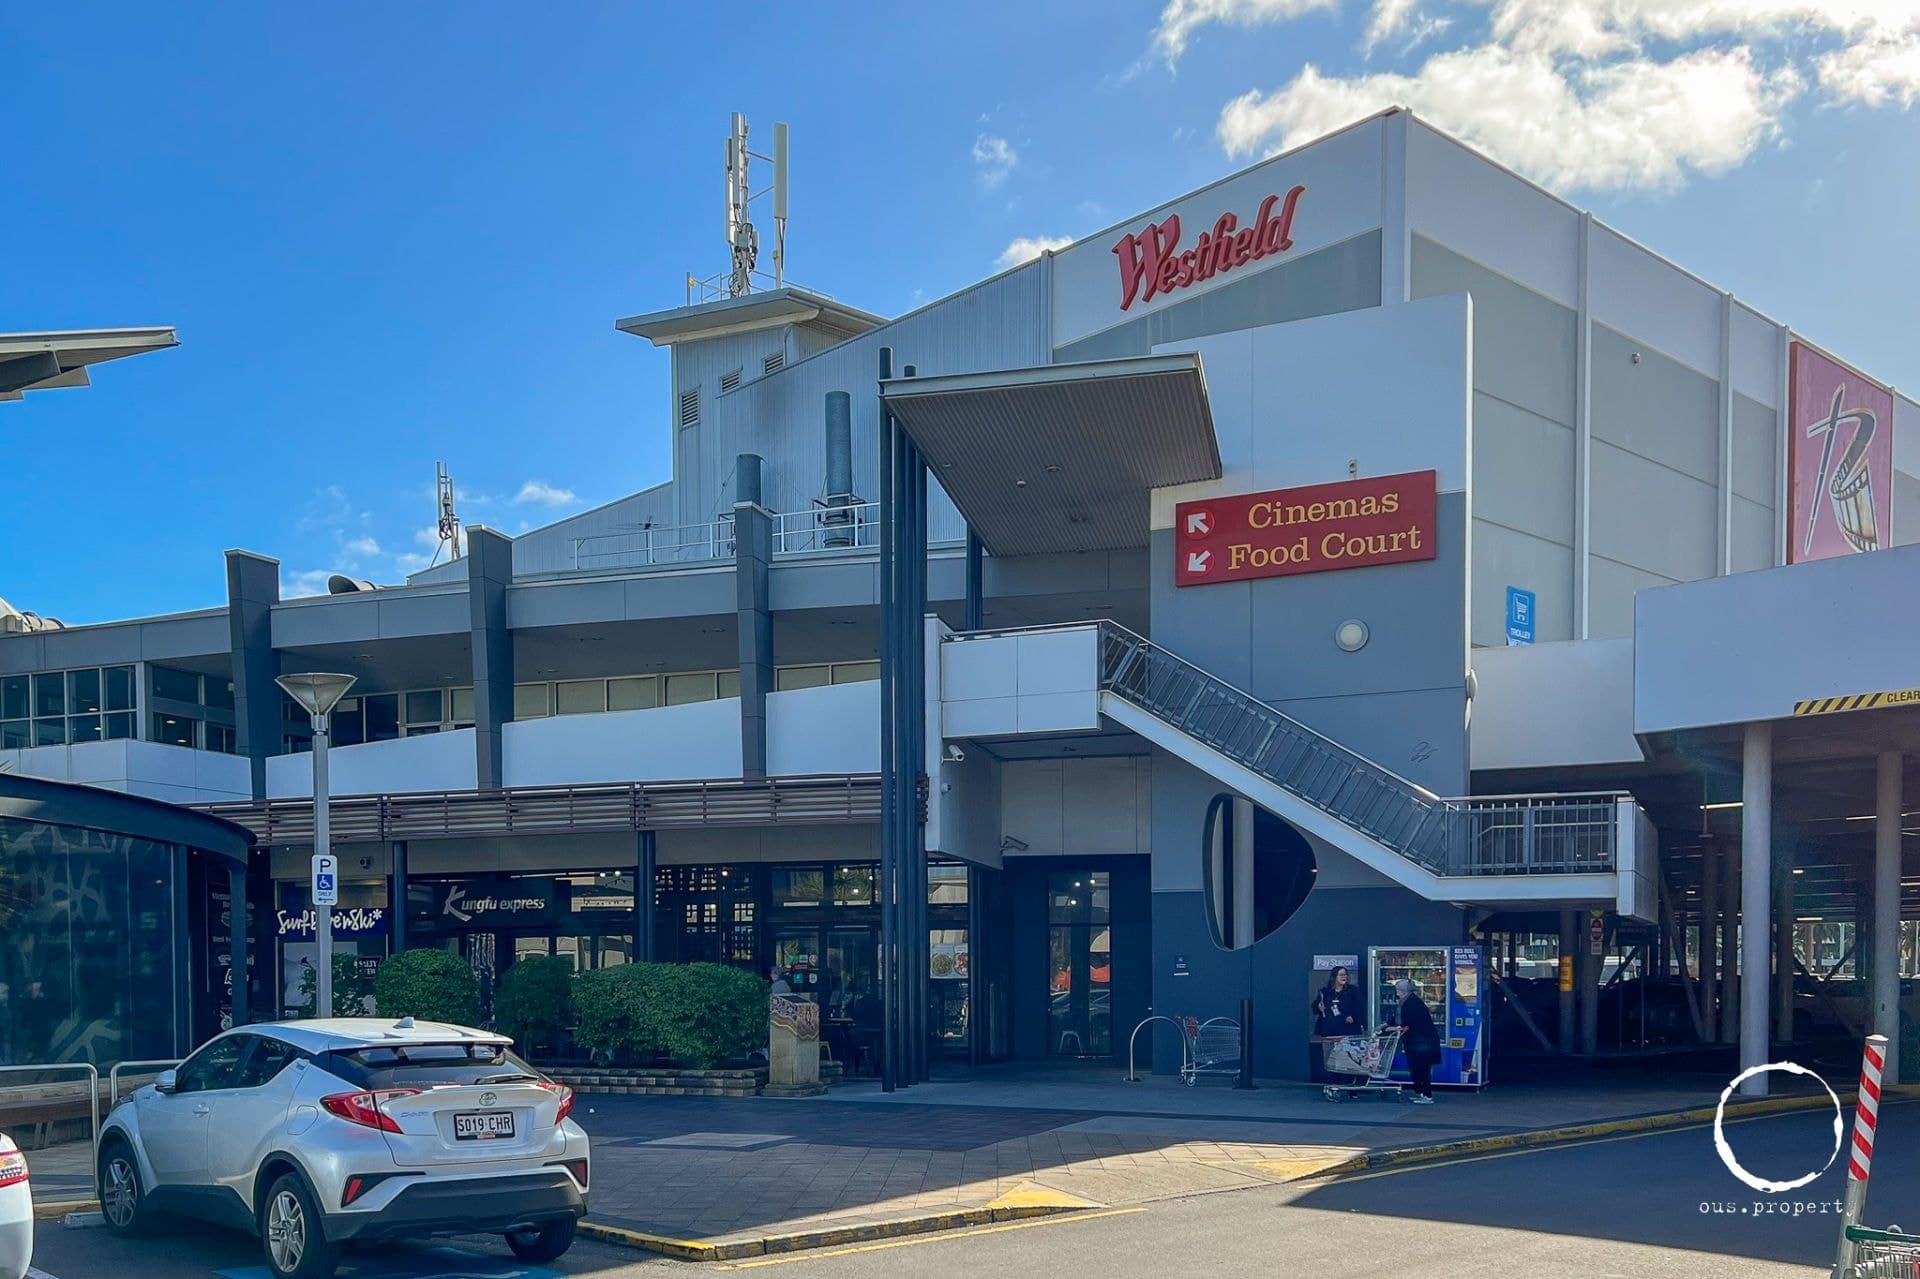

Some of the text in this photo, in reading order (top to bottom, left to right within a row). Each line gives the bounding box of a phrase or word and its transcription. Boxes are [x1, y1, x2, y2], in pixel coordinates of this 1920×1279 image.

[1112, 185, 1305, 311] Westfield
[1249, 492, 1399, 529] Cinemas
[1228, 525, 1422, 570] Food Court
[1887, 690, 1920, 703] CLEAR
[320, 859, 331, 873] P
[443, 885, 545, 921] Kungfu express
[1317, 958, 1329, 968] Pay
[457, 1116, 511, 1132] S019 CHR
